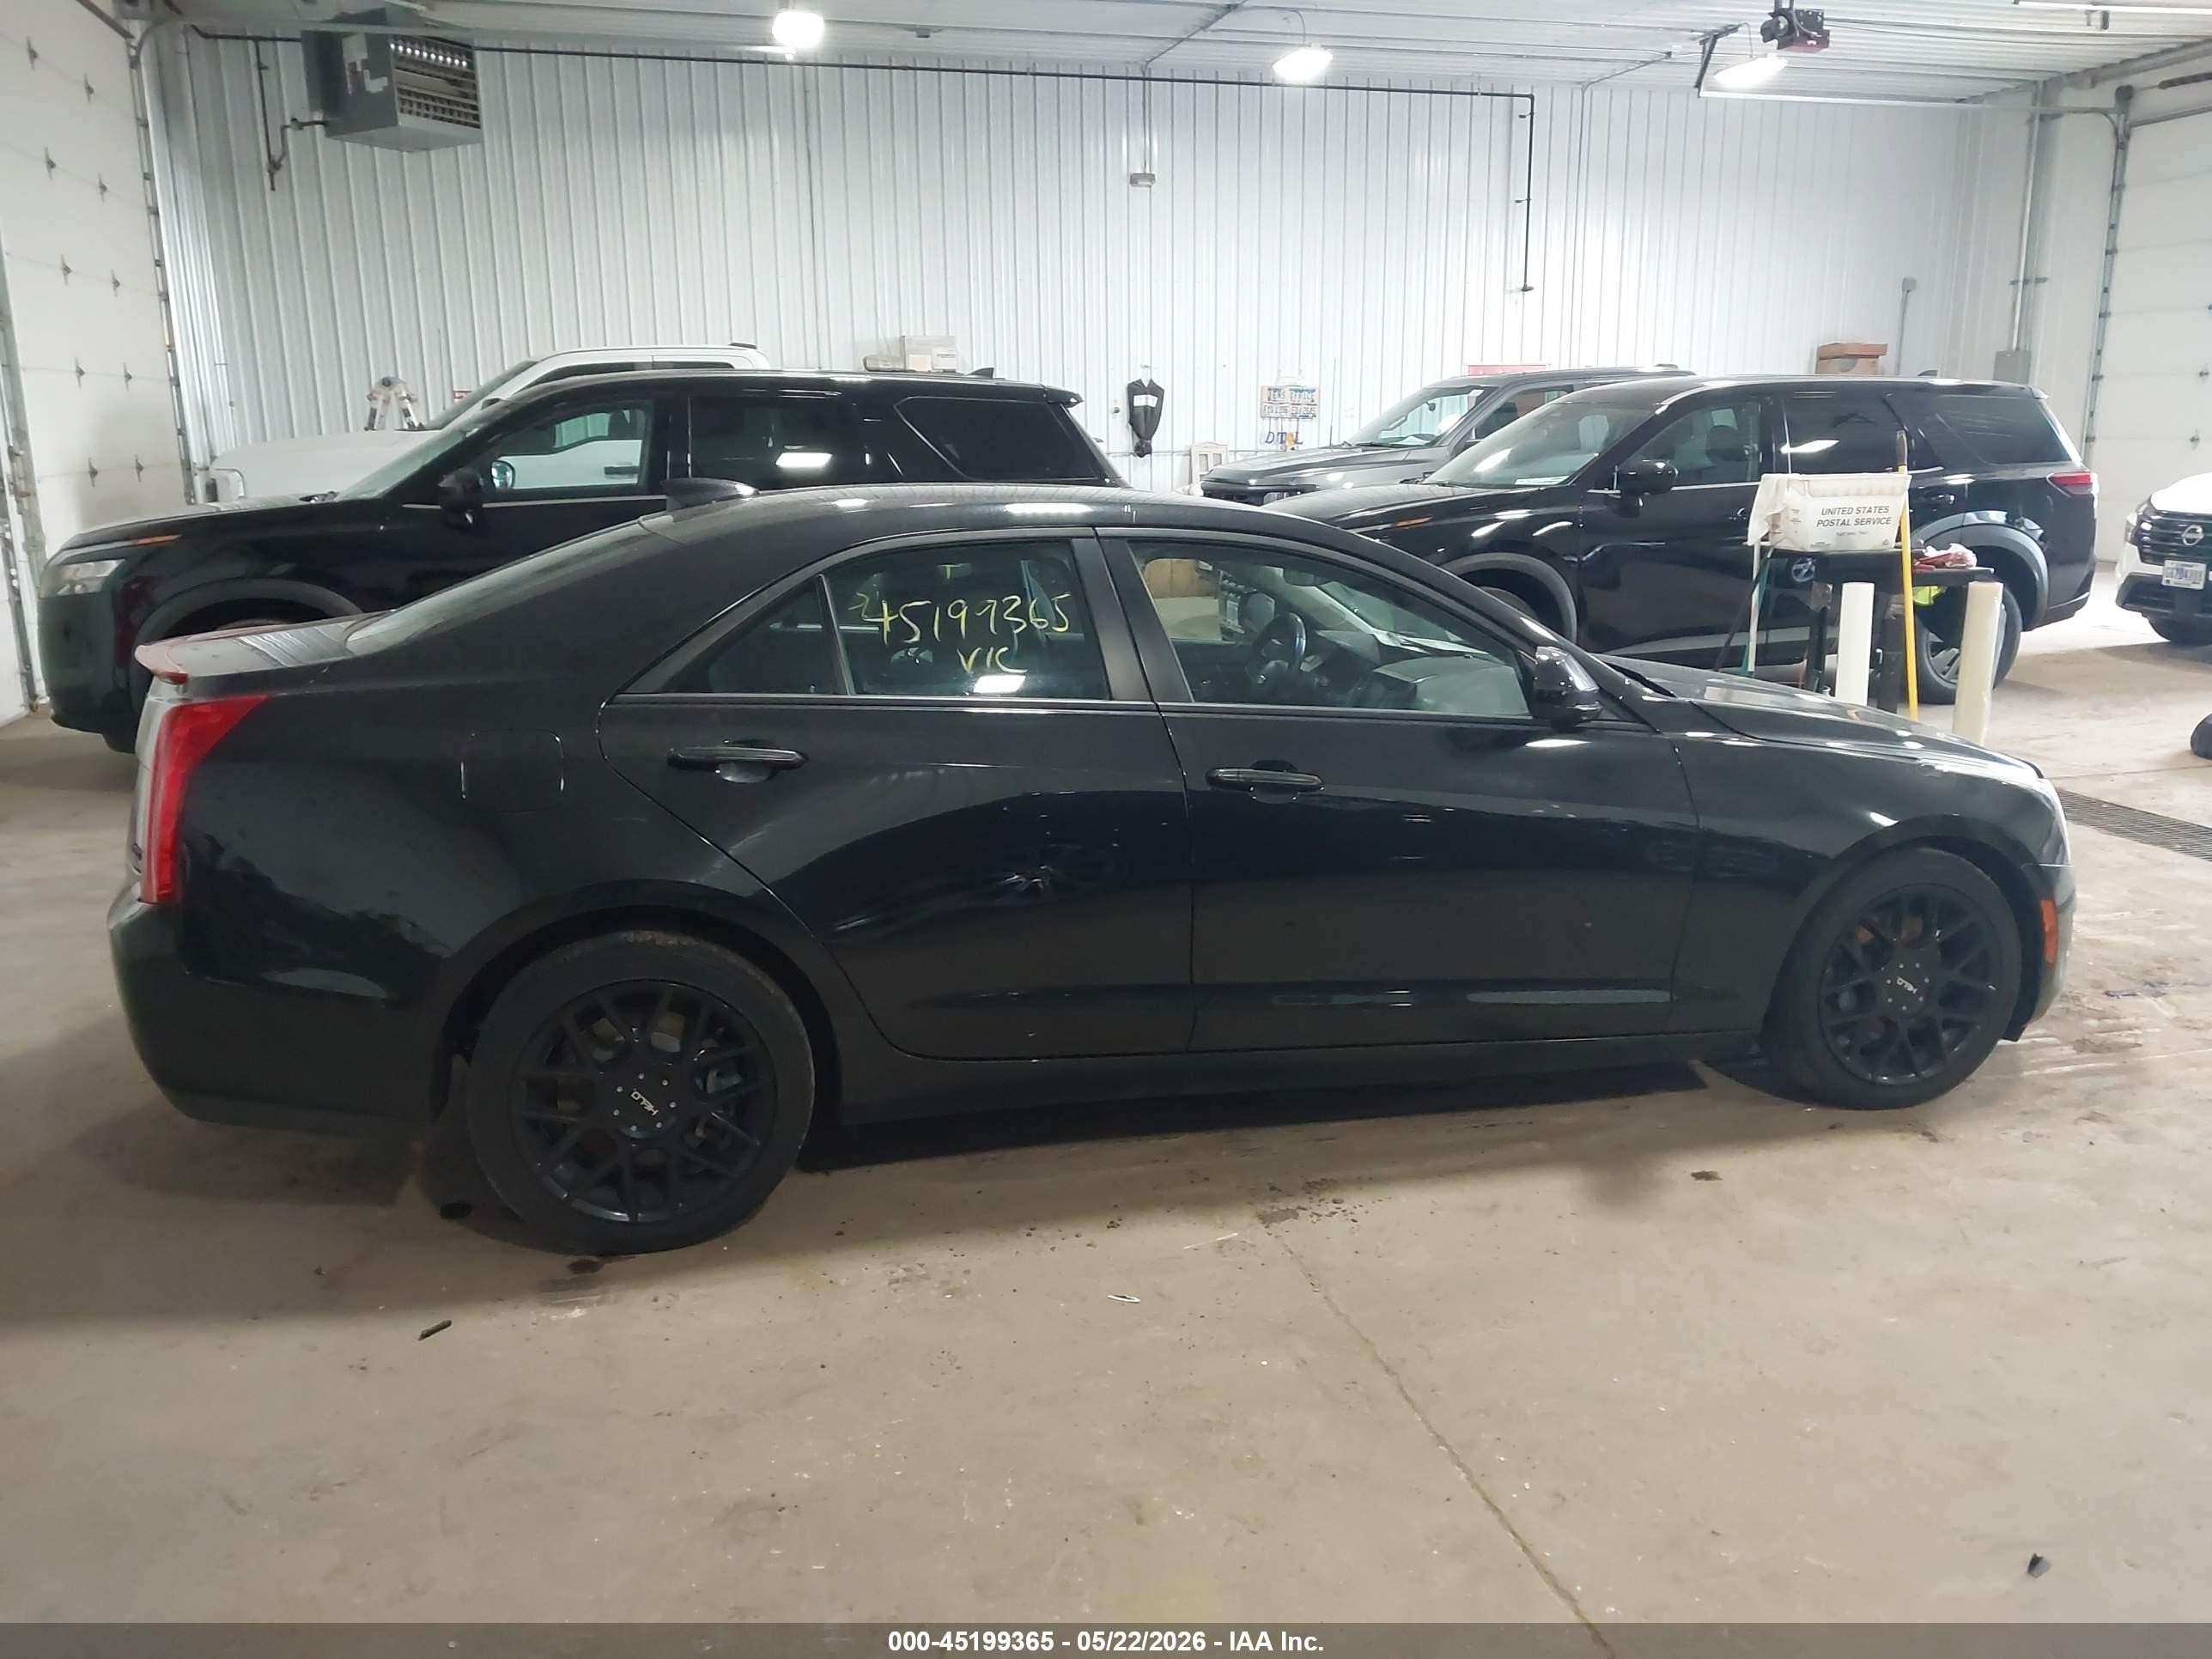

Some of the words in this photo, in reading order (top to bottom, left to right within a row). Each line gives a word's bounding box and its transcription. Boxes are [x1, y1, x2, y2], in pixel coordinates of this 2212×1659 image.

[1820, 507, 1854, 516] UNITED
[1856, 505, 1890, 514] STATES
[1816, 518, 1851, 527] POSTAL
[1854, 517, 1893, 526] SERVICE
